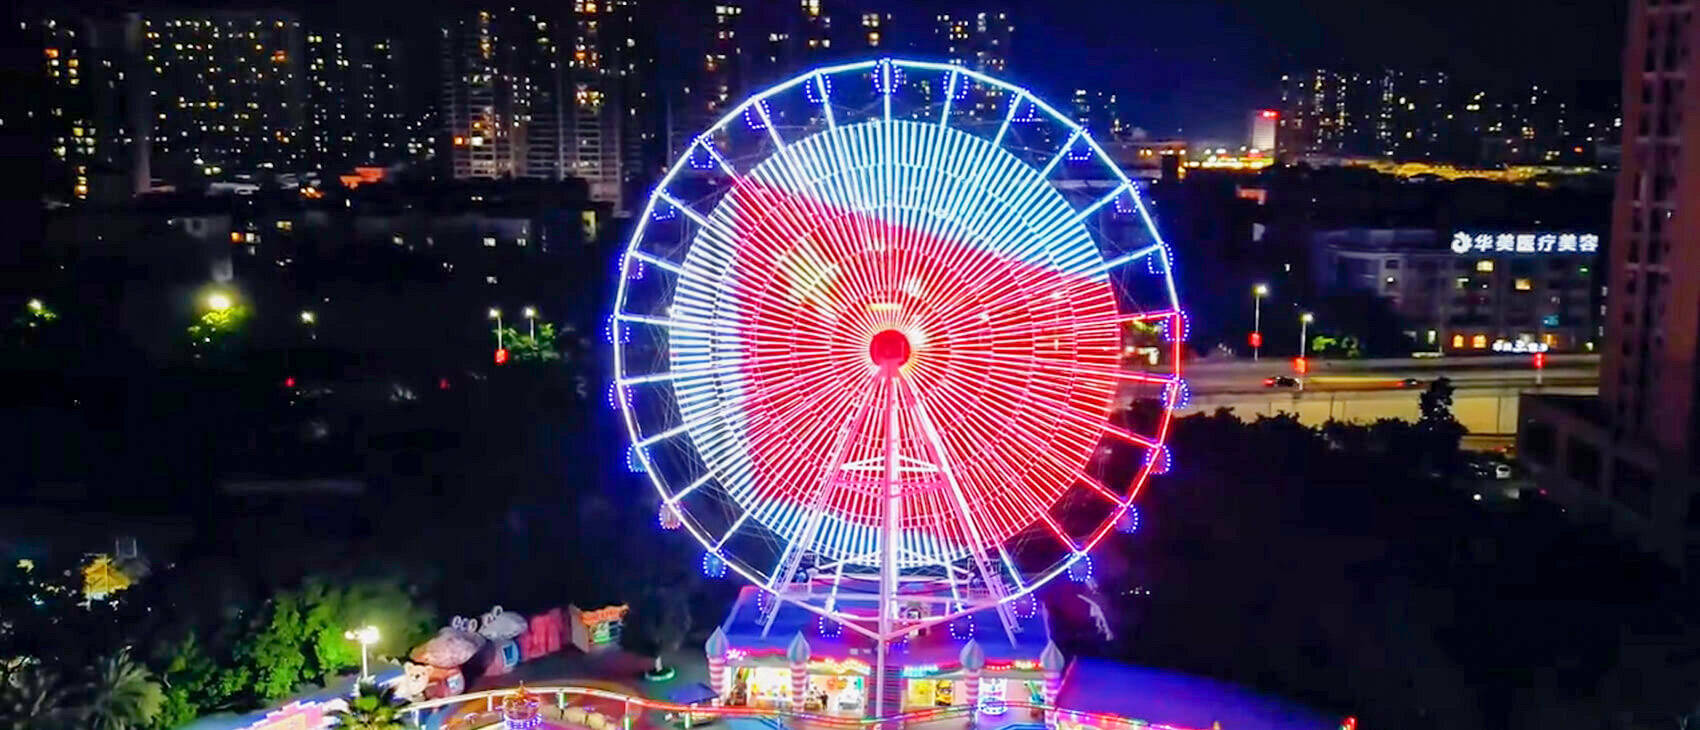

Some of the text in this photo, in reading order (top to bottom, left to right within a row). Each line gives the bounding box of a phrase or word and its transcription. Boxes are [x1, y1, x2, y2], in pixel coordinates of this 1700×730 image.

[1474, 233, 1599, 252] 华美医疗美容
